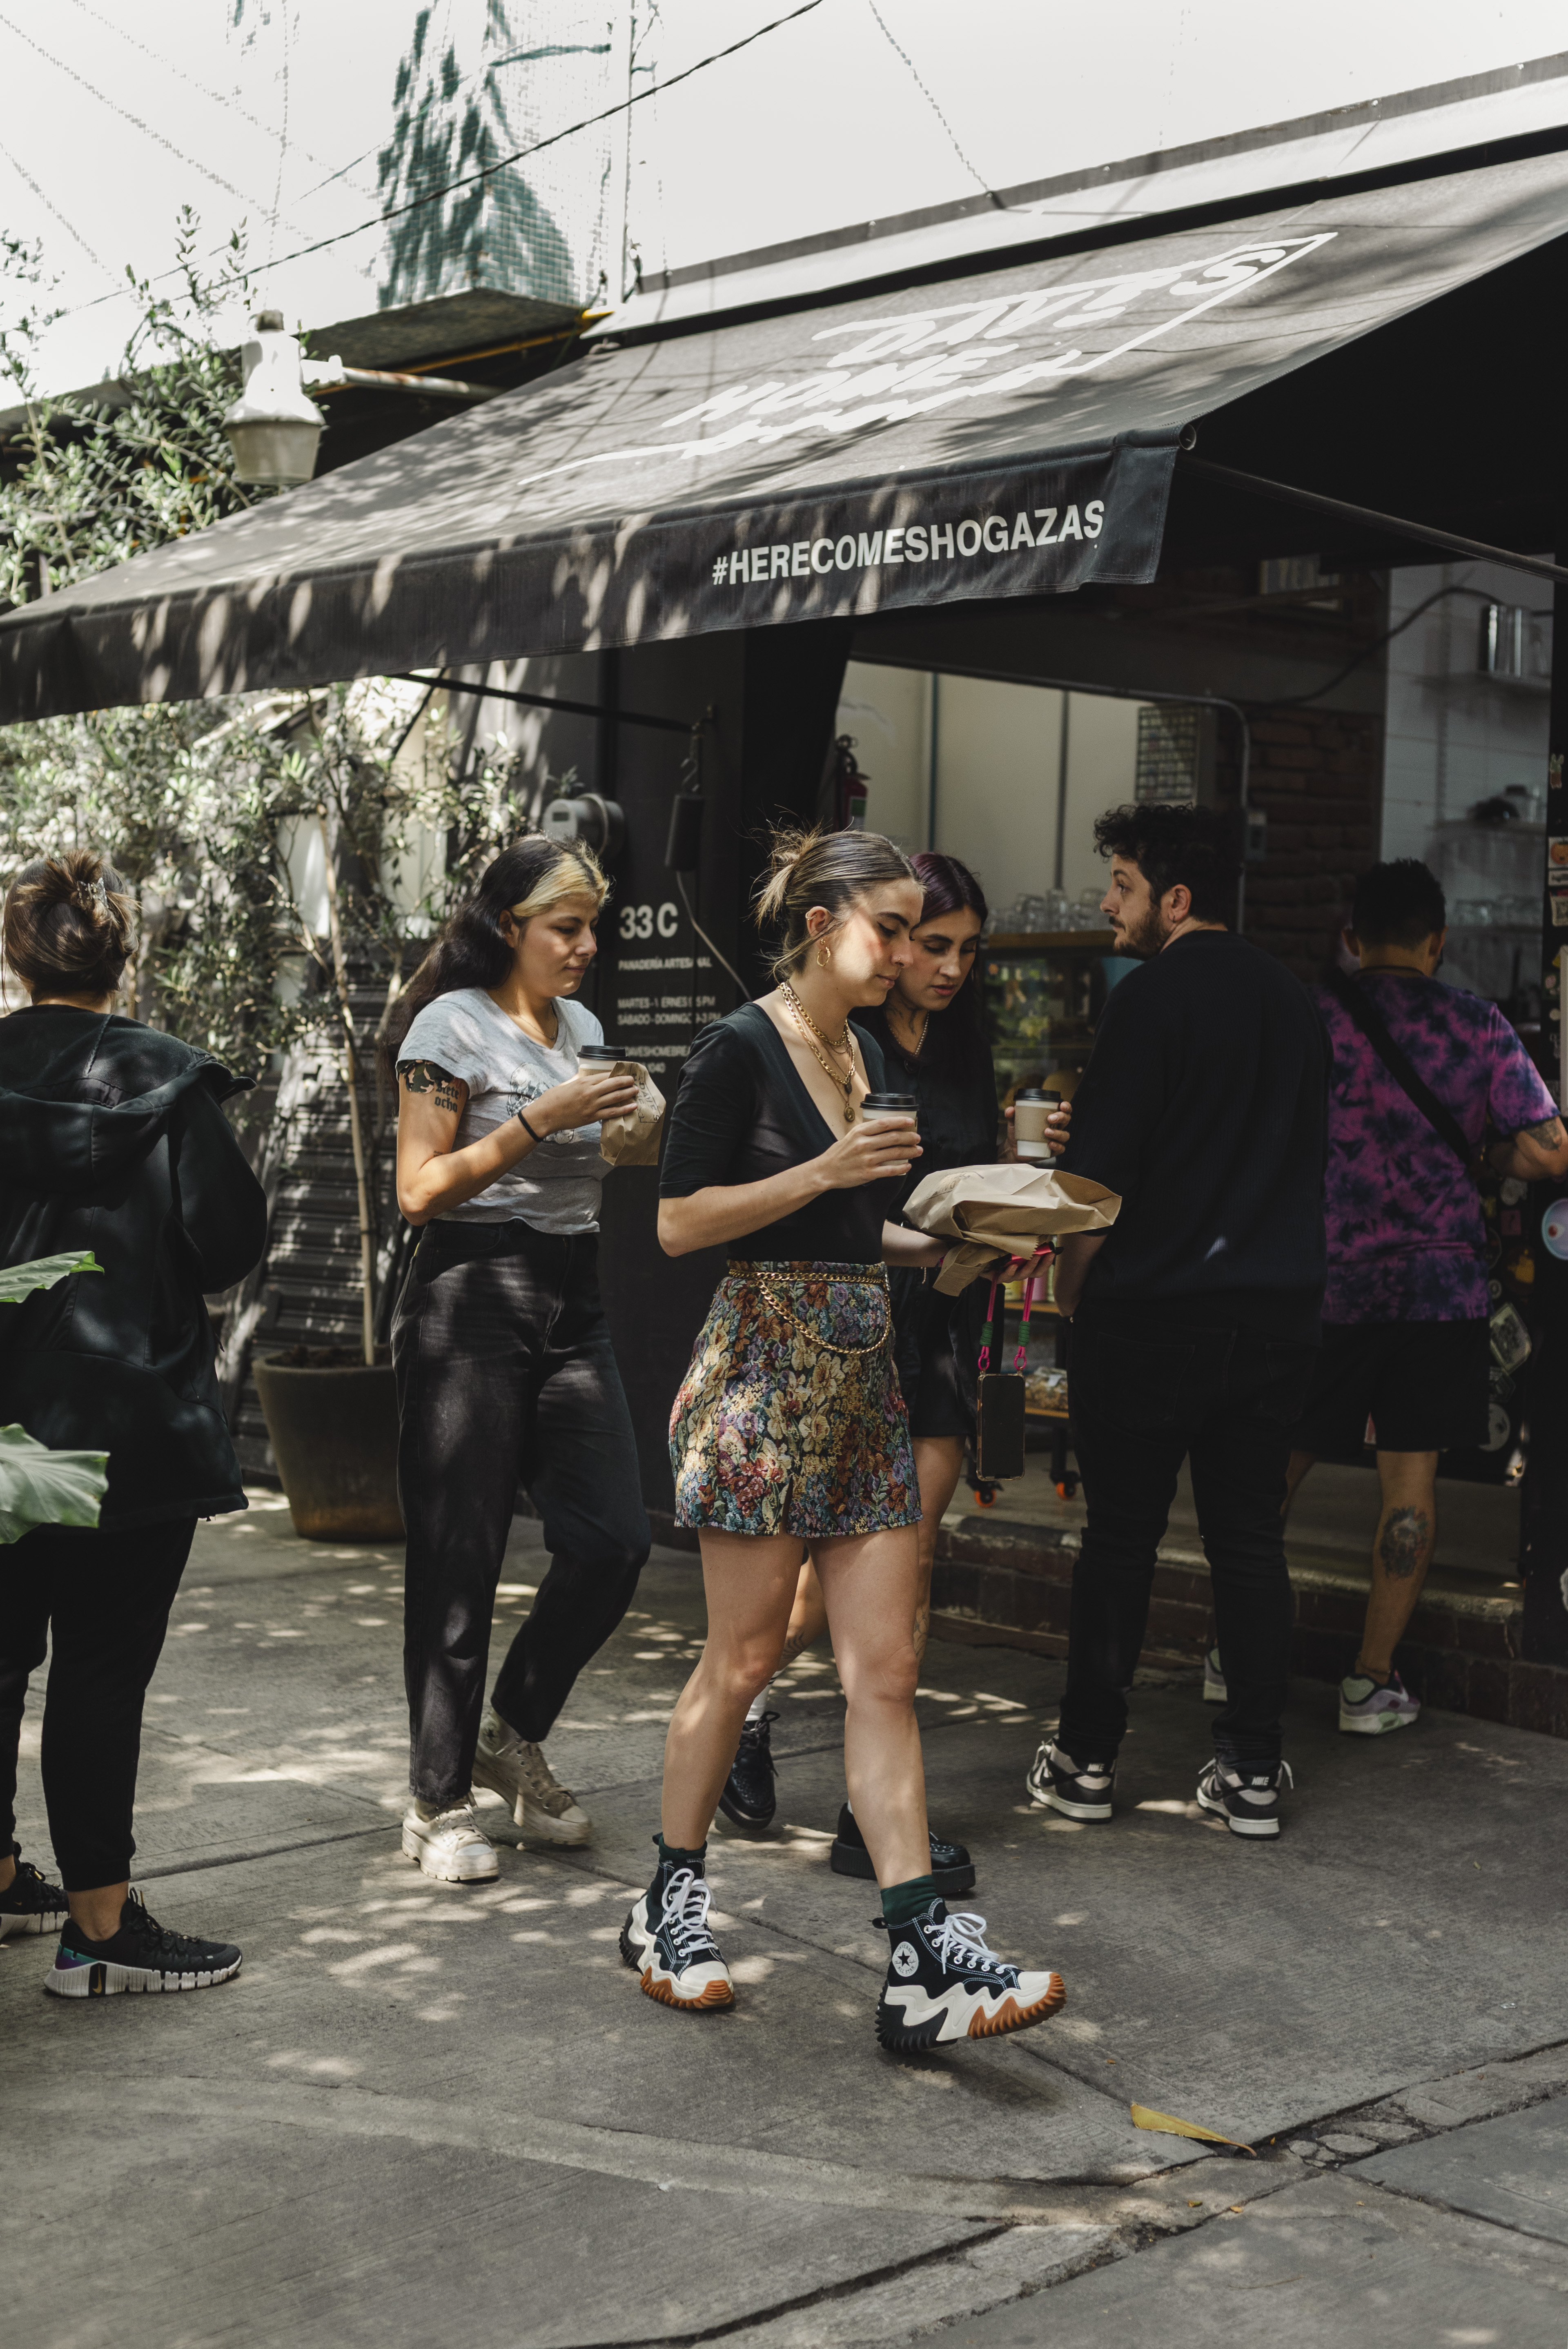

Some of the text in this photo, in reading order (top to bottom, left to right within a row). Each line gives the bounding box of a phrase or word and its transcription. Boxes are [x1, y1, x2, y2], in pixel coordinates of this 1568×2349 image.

[662, 343, 1018, 427] HOME
[713, 500, 1104, 585] #HERECOMESHOGAZAS
[434, 1097, 458, 1113] ocho
[1087, 1763, 1105, 1772] NIKE
[1252, 1776, 1270, 1786] NIKE
[895, 1944, 913, 1955] CONVERSE
